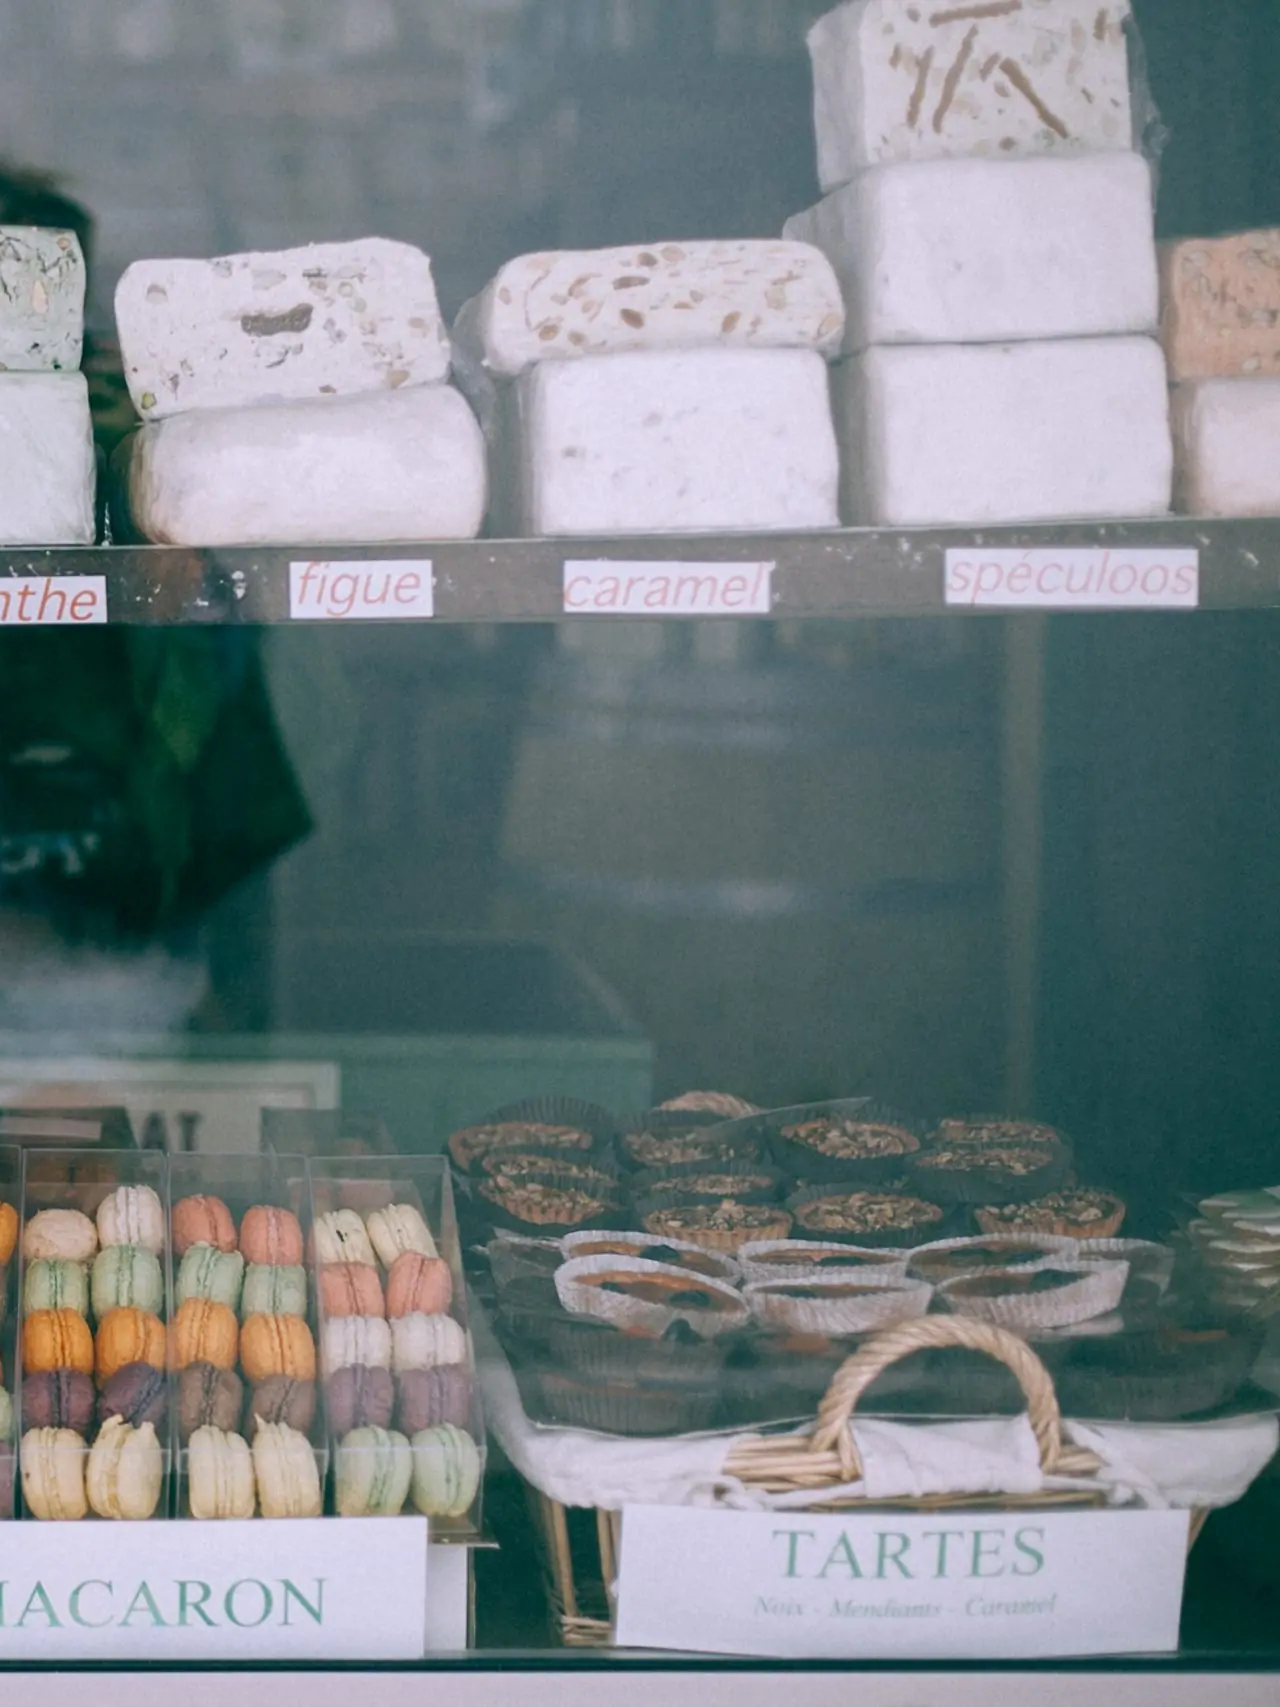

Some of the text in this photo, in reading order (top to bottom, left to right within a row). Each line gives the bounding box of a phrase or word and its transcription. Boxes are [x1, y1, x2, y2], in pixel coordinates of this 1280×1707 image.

[298, 560, 423, 617] figue
[563, 561, 766, 608] caramel
[947, 549, 1195, 604] spéculoos
[772, 1526, 1048, 1580] TARTES
[964, 1592, 1058, 1617] Caramel
